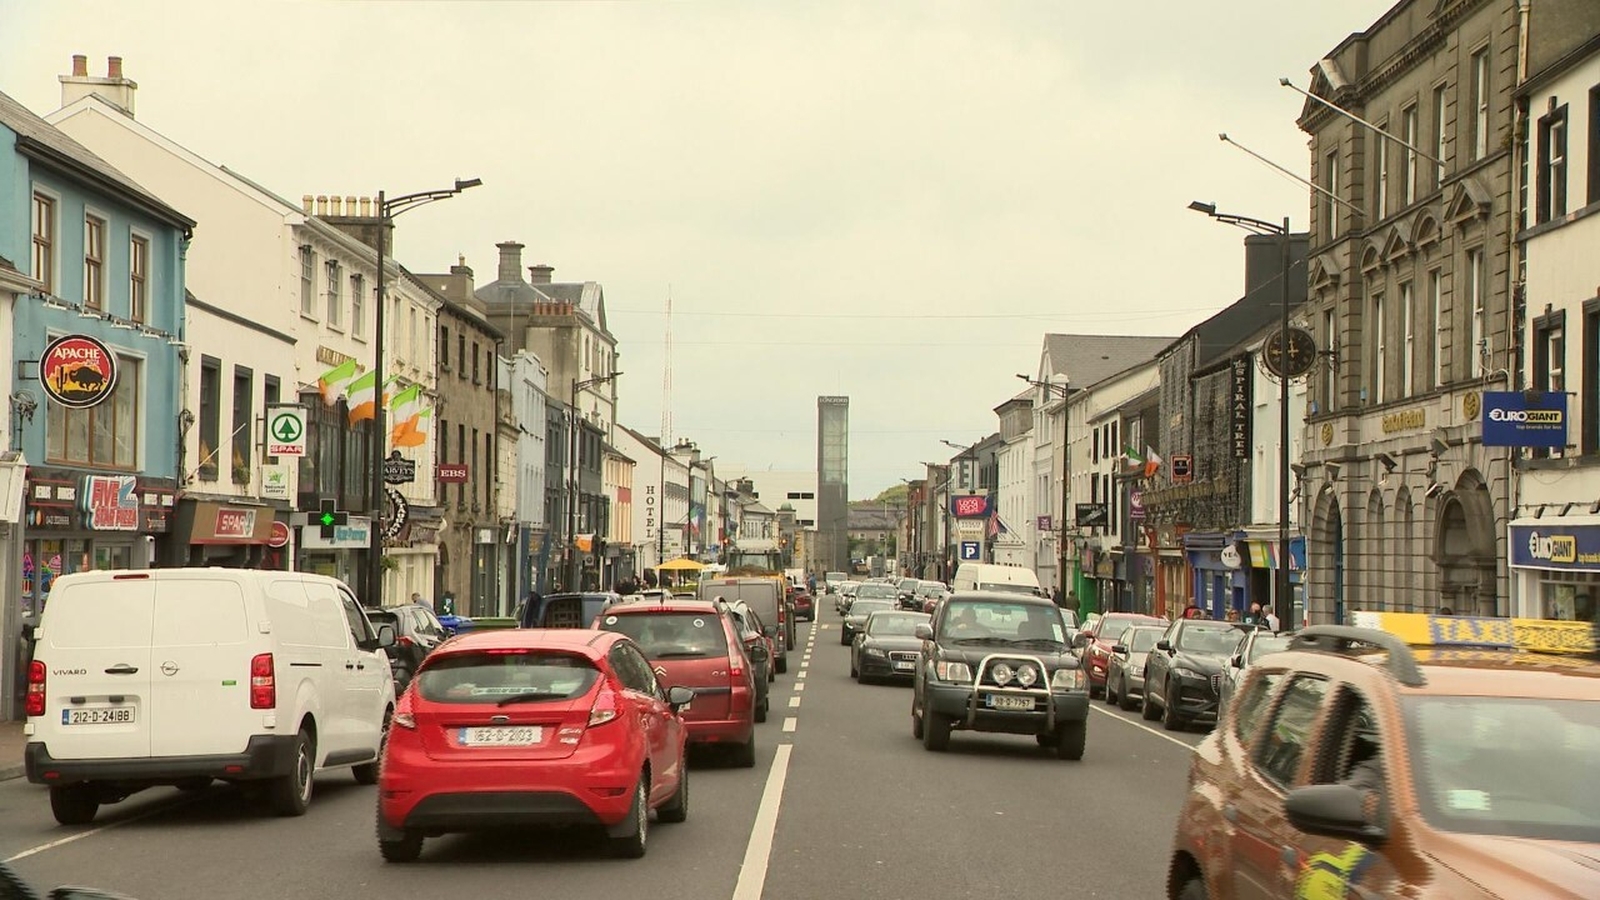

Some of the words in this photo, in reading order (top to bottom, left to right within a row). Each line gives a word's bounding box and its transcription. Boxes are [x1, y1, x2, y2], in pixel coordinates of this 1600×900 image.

[54, 347, 101, 360] APACHE
[1235, 368, 1246, 418] SPIRAL
[1234, 424, 1246, 457] TREE
[271, 446, 302, 454] SPAR
[441, 470, 465, 478] EBS
[92, 480, 119, 509] FIVE
[645, 485, 655, 538] HOTEL
[221, 514, 245, 531] SPAR
[965, 547, 975, 558] P
[1433, 616, 1510, 642] TAXI
[73, 710, 130, 724] 212-D-24188
